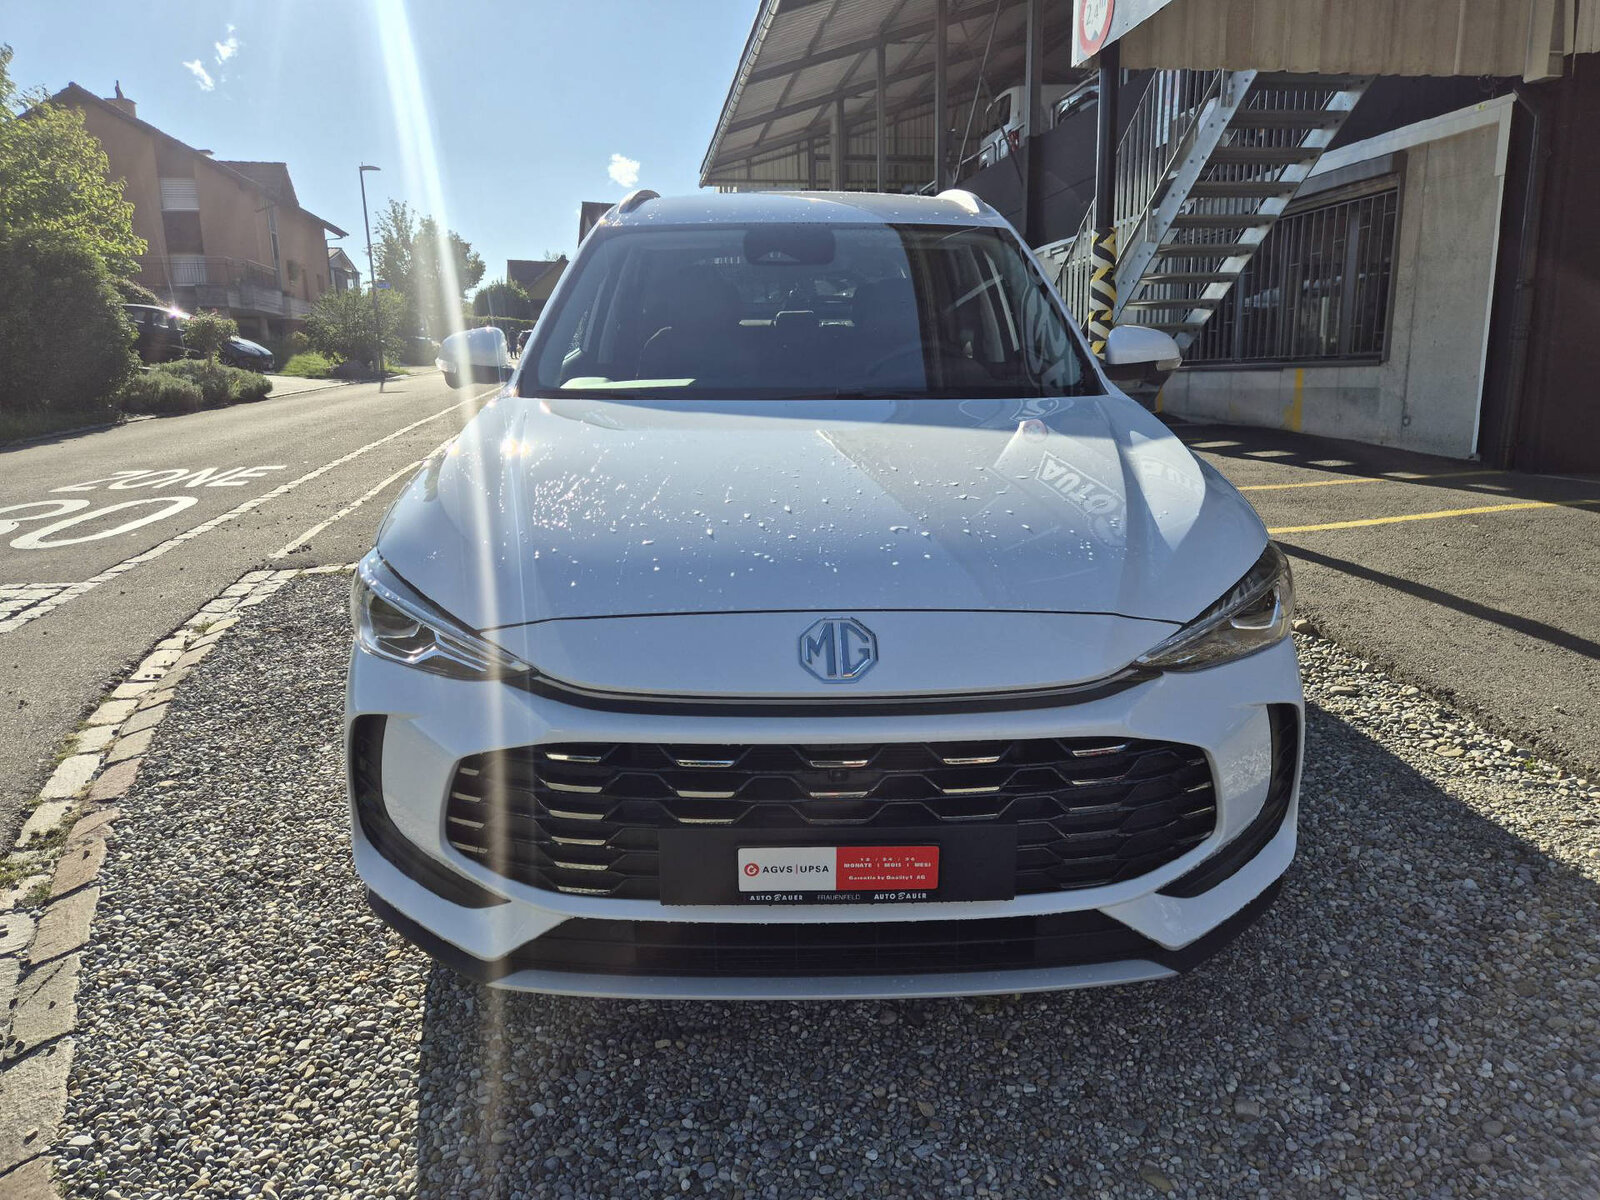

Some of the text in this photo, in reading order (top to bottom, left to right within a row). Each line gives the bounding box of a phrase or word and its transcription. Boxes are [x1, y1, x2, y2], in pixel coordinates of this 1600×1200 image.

[48, 465, 287, 492] ZONE
[804, 622, 871, 679] MG
[762, 865, 830, 874] AGVS UPSA
